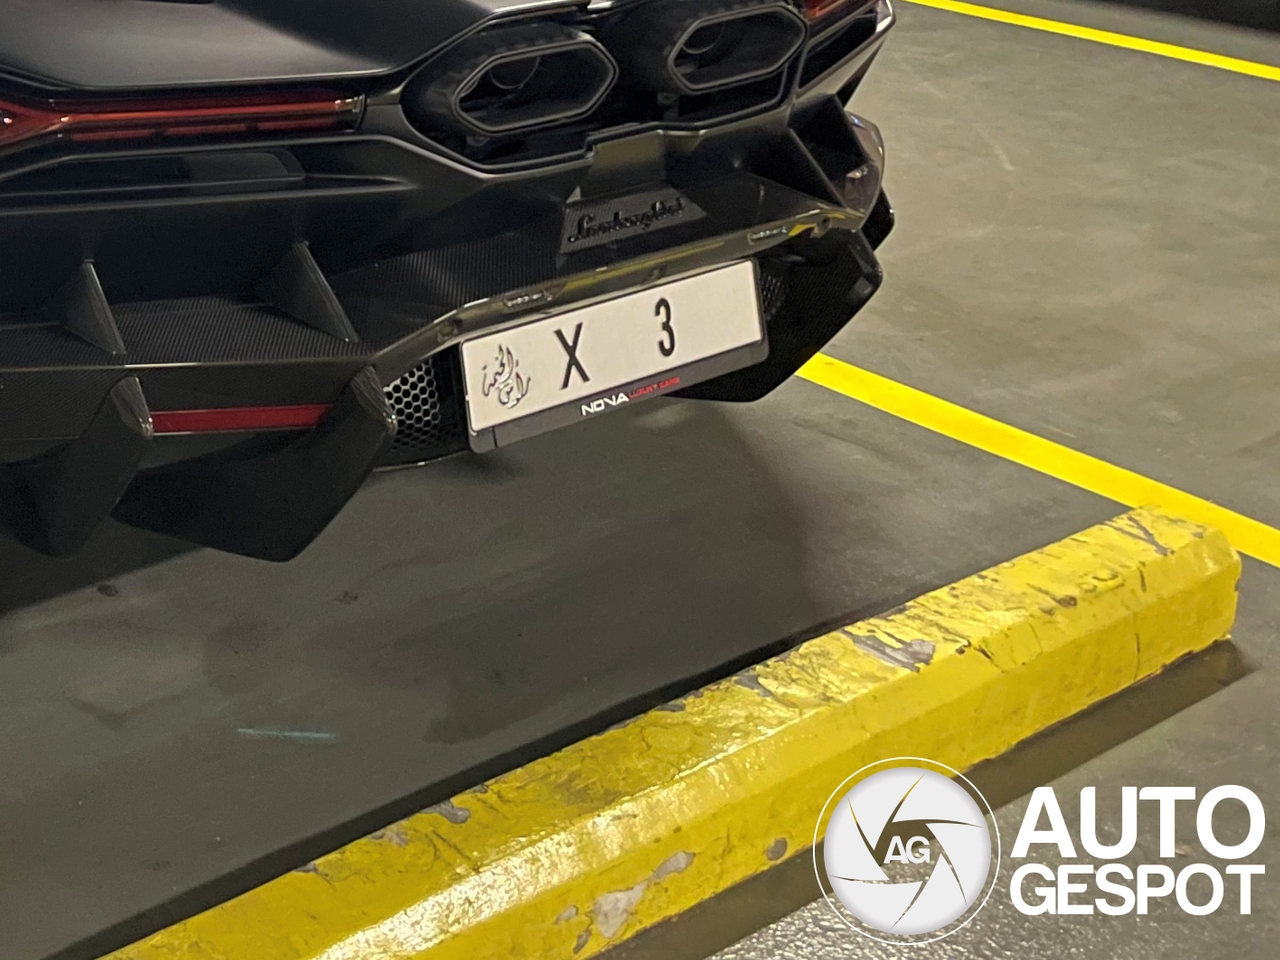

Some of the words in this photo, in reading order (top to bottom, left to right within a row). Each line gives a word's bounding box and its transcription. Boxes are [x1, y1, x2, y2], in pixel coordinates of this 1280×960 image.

[554, 322, 590, 390] X
[655, 297, 675, 357] 3
[581, 392, 629, 416] NOVA
